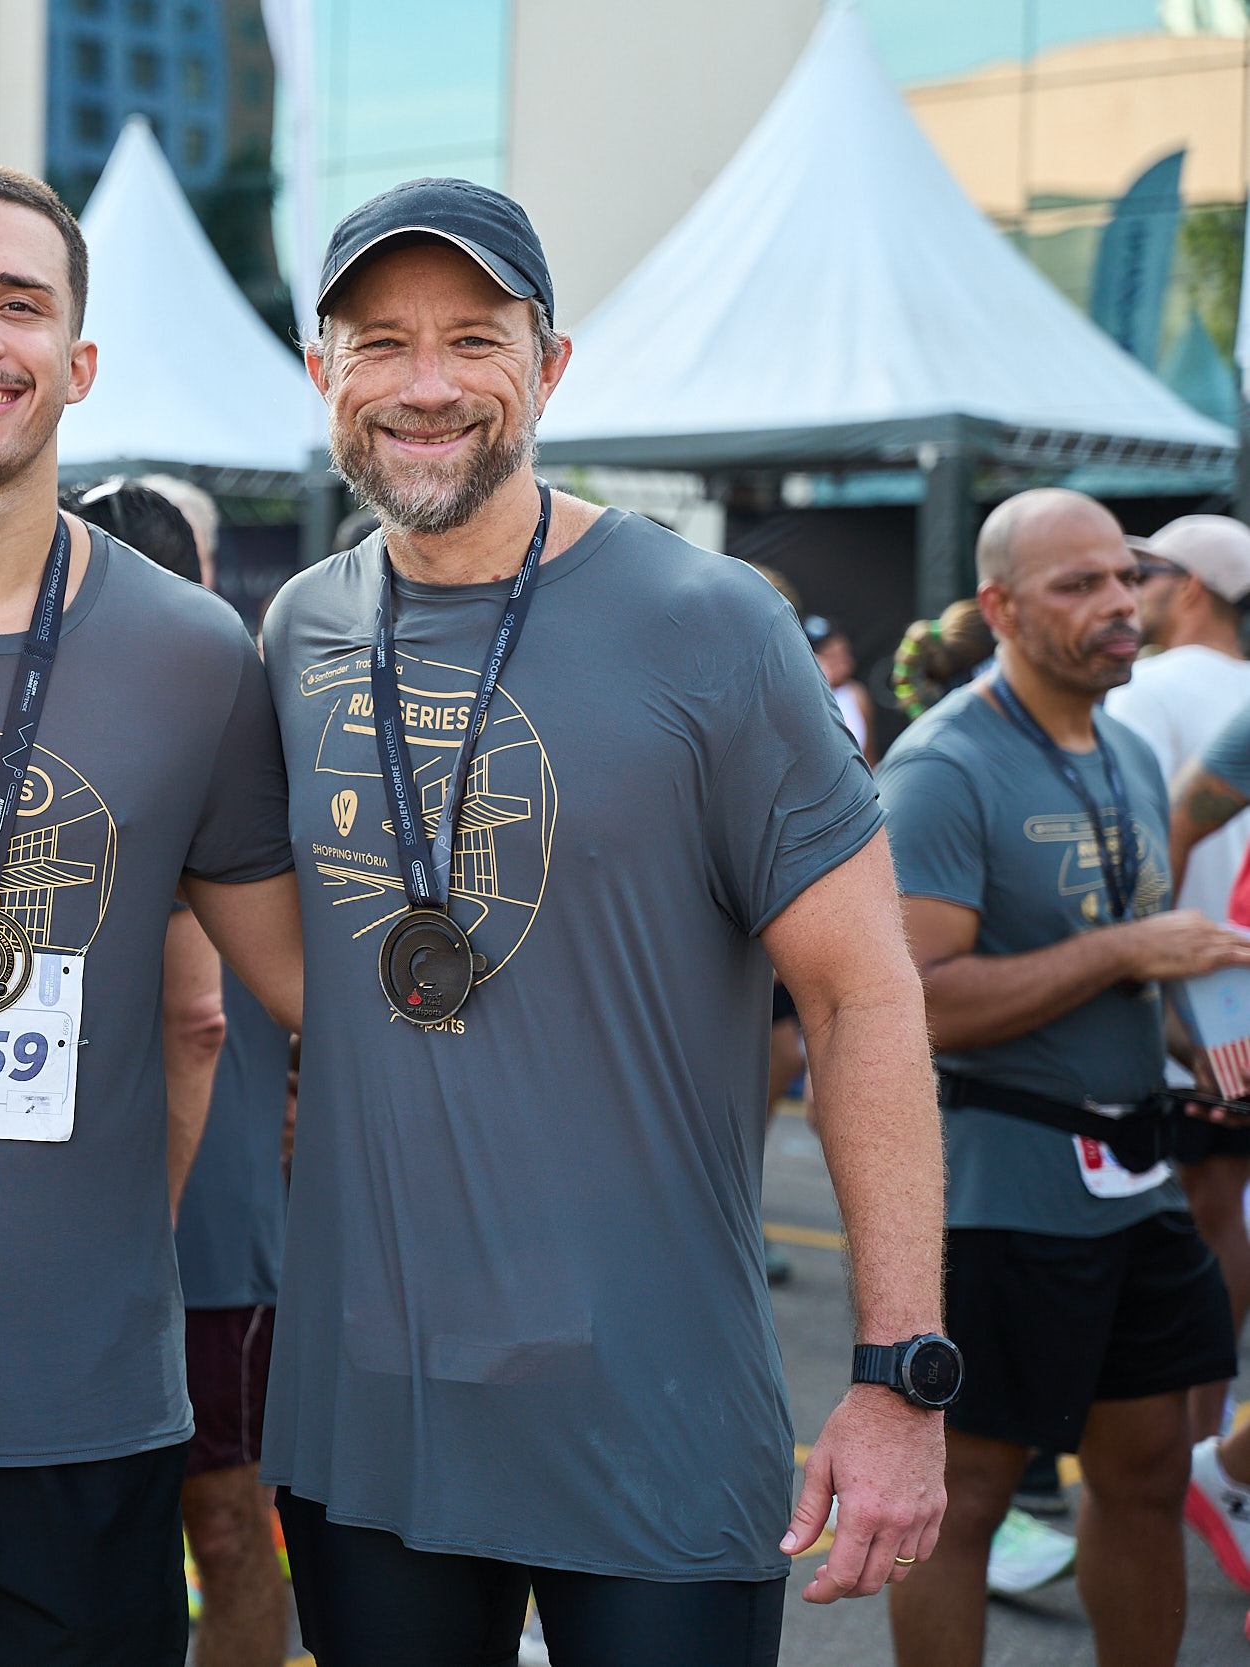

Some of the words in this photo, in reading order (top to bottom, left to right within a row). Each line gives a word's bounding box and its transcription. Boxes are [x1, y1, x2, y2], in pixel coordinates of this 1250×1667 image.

[55, 539, 67, 568] QUEM
[48, 565, 62, 599] CORRE
[39, 600, 56, 642] ENTENDE
[504, 613, 515, 626] SÓ
[494, 628, 510, 657] QUEM
[314, 664, 350, 683] Santander
[485, 658, 500, 694] CORRE
[384, 718, 398, 763] ENTENDE
[391, 764, 404, 799] CORRE
[397, 800, 410, 830] QUEM
[403, 831, 414, 846] SÓ
[312, 843, 352, 861] SHOPPING
[353, 852, 388, 868] VITÓRIA
